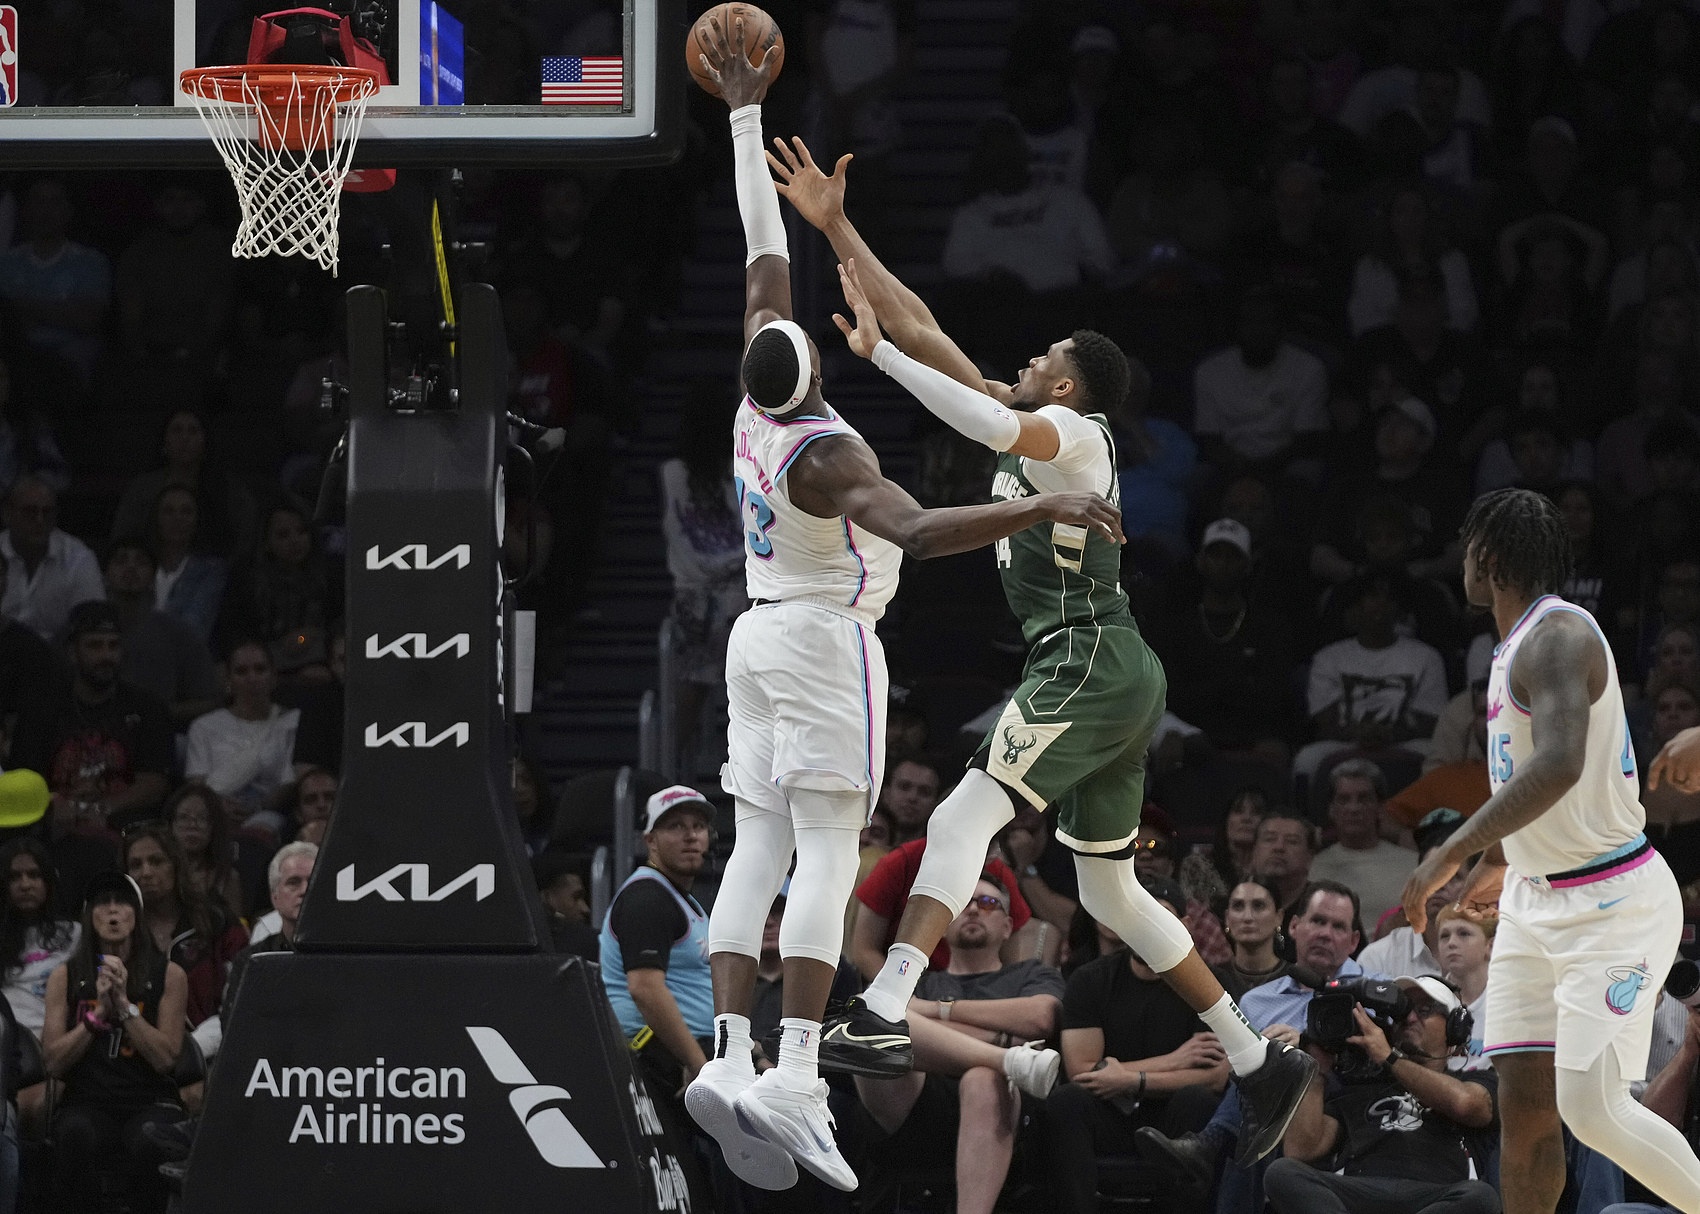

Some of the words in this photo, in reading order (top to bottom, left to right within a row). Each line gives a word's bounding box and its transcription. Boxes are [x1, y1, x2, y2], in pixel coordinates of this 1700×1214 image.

[995, 536, 1012, 570] 4
[245, 1057, 466, 1099] American
[288, 1103, 466, 1145] Airlines
